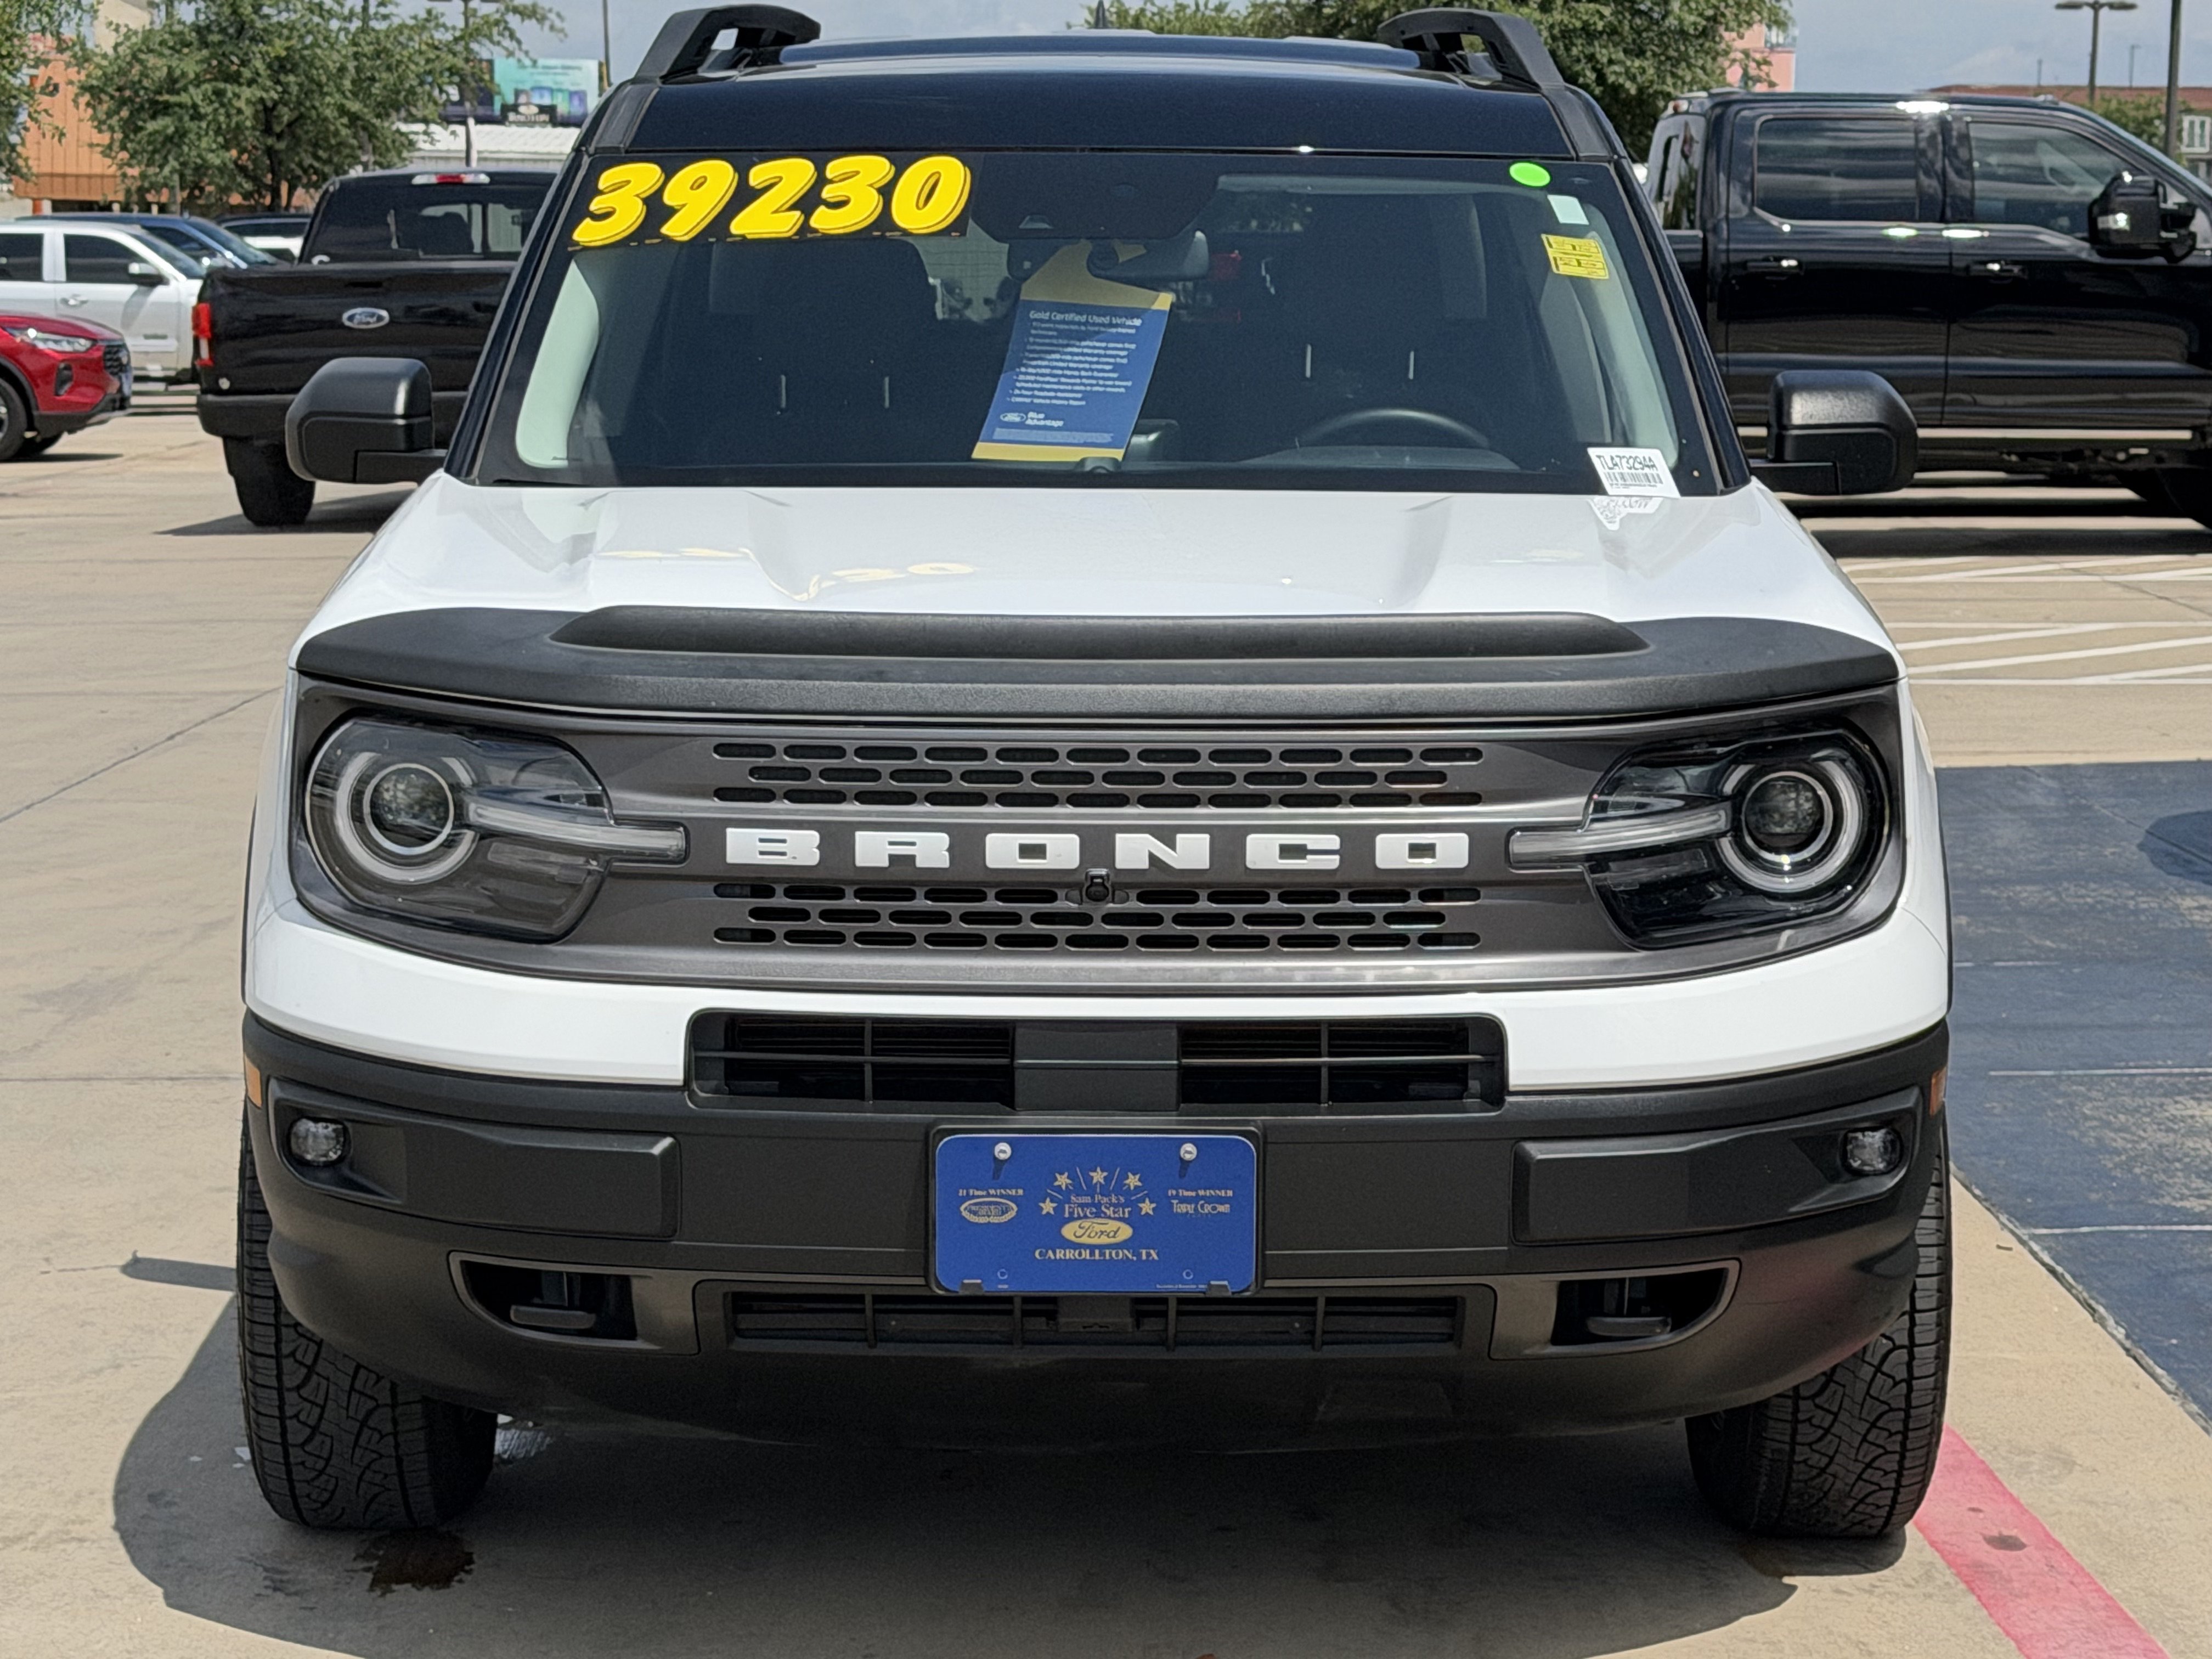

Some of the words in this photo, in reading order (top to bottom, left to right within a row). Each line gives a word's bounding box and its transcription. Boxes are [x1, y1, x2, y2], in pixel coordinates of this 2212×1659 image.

[572, 155, 970, 246] 39230
[1029, 311, 1049, 320] Gold
[1051, 312, 1087, 323] Certified
[1088, 313, 1109, 324] Used
[1111, 316, 1142, 326] Vehicle
[726, 827, 1469, 870] BRONCO
[1070, 1194, 1091, 1204] Sam
[1094, 1194, 1125, 1204] Pack's
[1178, 1188, 1197, 1197] Time
[1064, 1204, 1097, 1218] Five
[1101, 1204, 1132, 1218] Star
[1073, 1221, 1121, 1239] Ford
[1035, 1248, 1137, 1261] CARROLLTON,
[1139, 1249, 1159, 1260] TX
